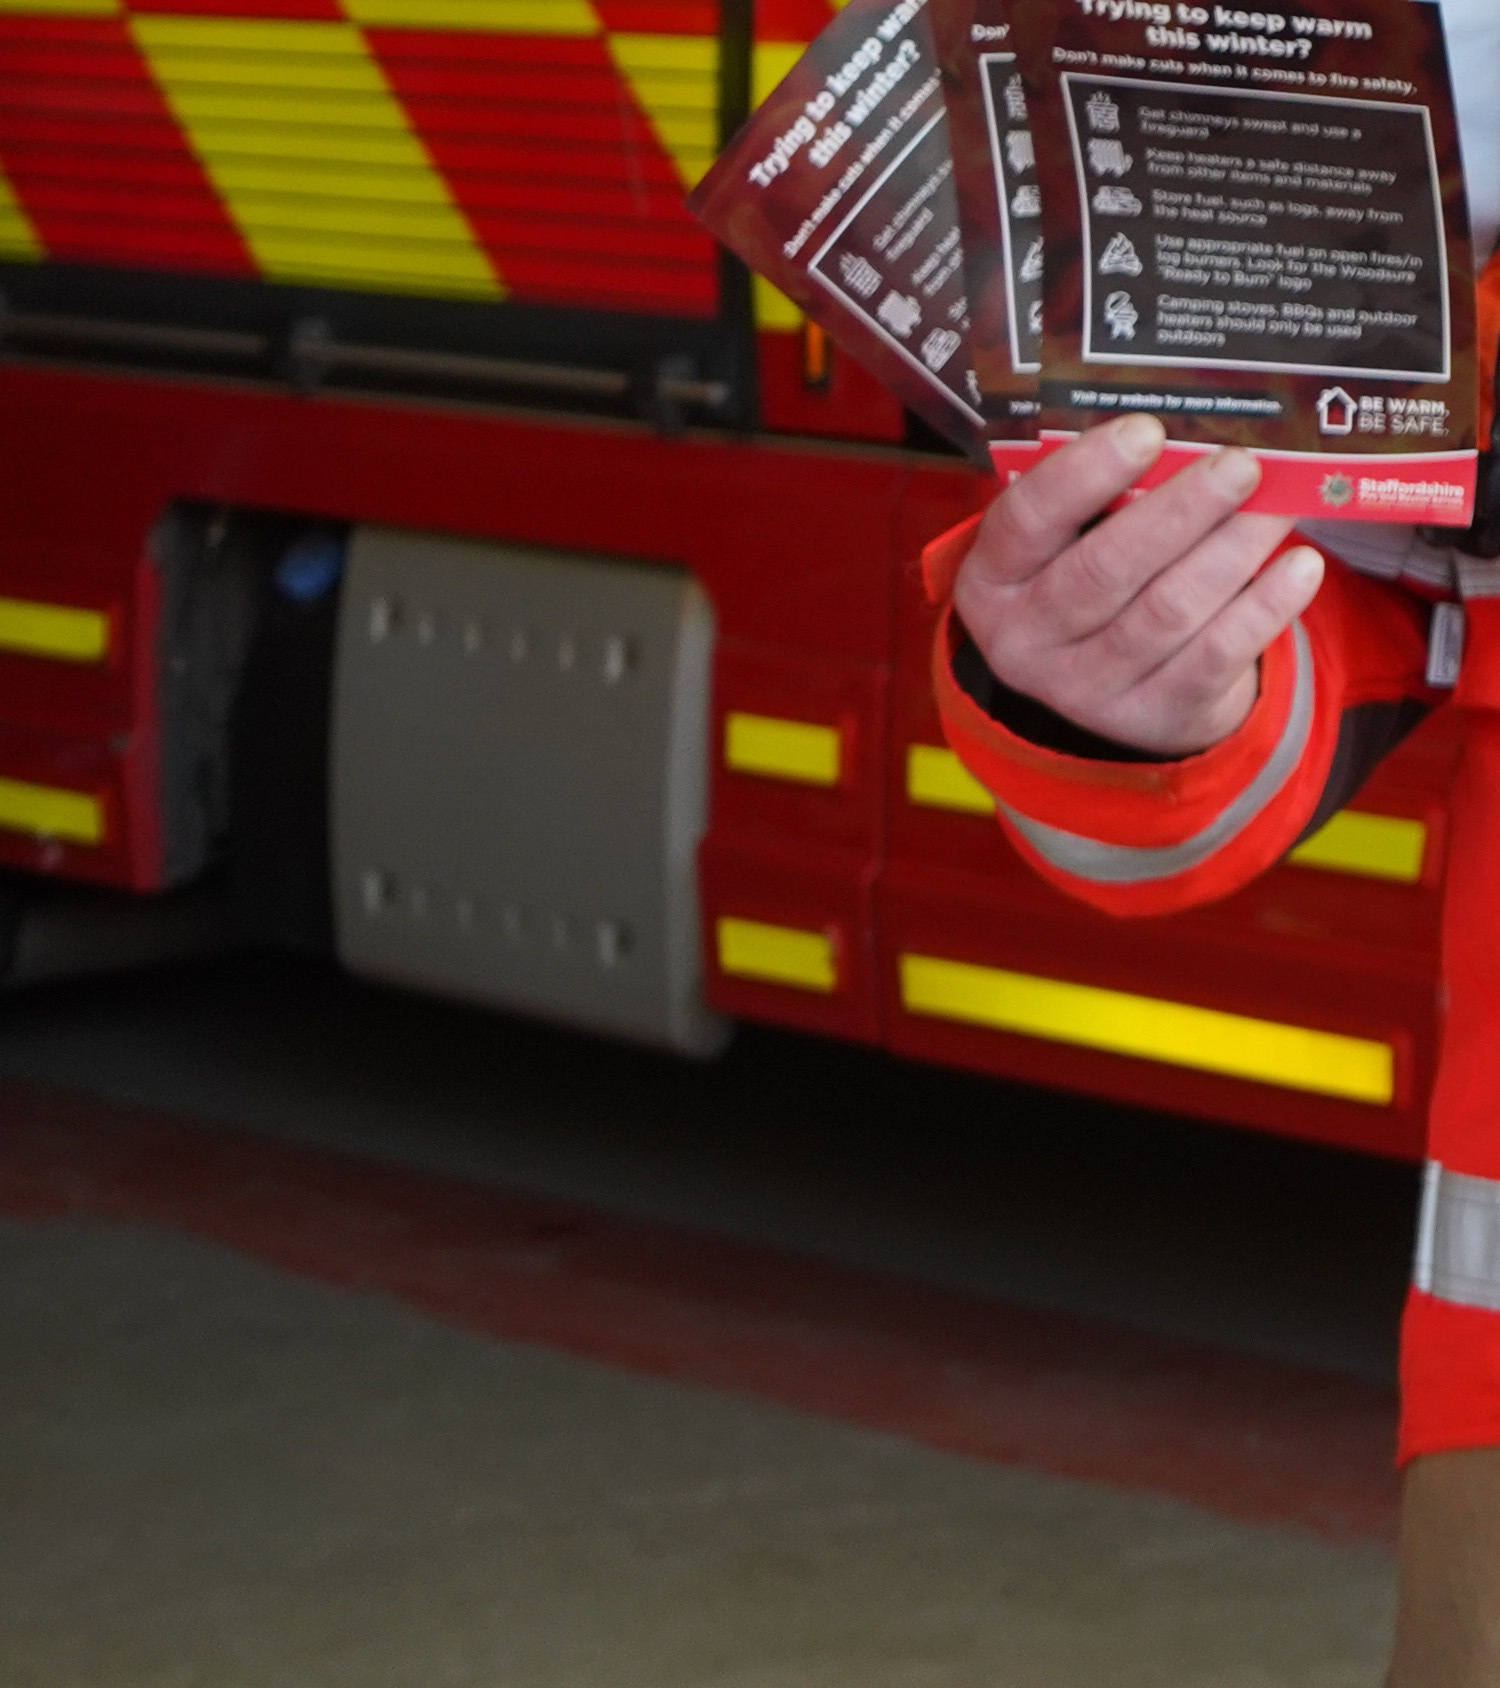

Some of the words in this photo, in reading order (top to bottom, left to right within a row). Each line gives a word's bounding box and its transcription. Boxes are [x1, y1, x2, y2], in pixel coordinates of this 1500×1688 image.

[1146, 26, 1201, 49] this
[1206, 32, 1312, 58] winter?
[1176, 3, 1209, 25] to
[1214, 5, 1286, 34] keep
[1292, 16, 1372, 40] warm
[749, 115, 817, 187] Trying
[805, 90, 836, 122] to
[826, 36, 883, 97] keep
[809, 121, 852, 168] this
[845, 39, 921, 127] winter?
